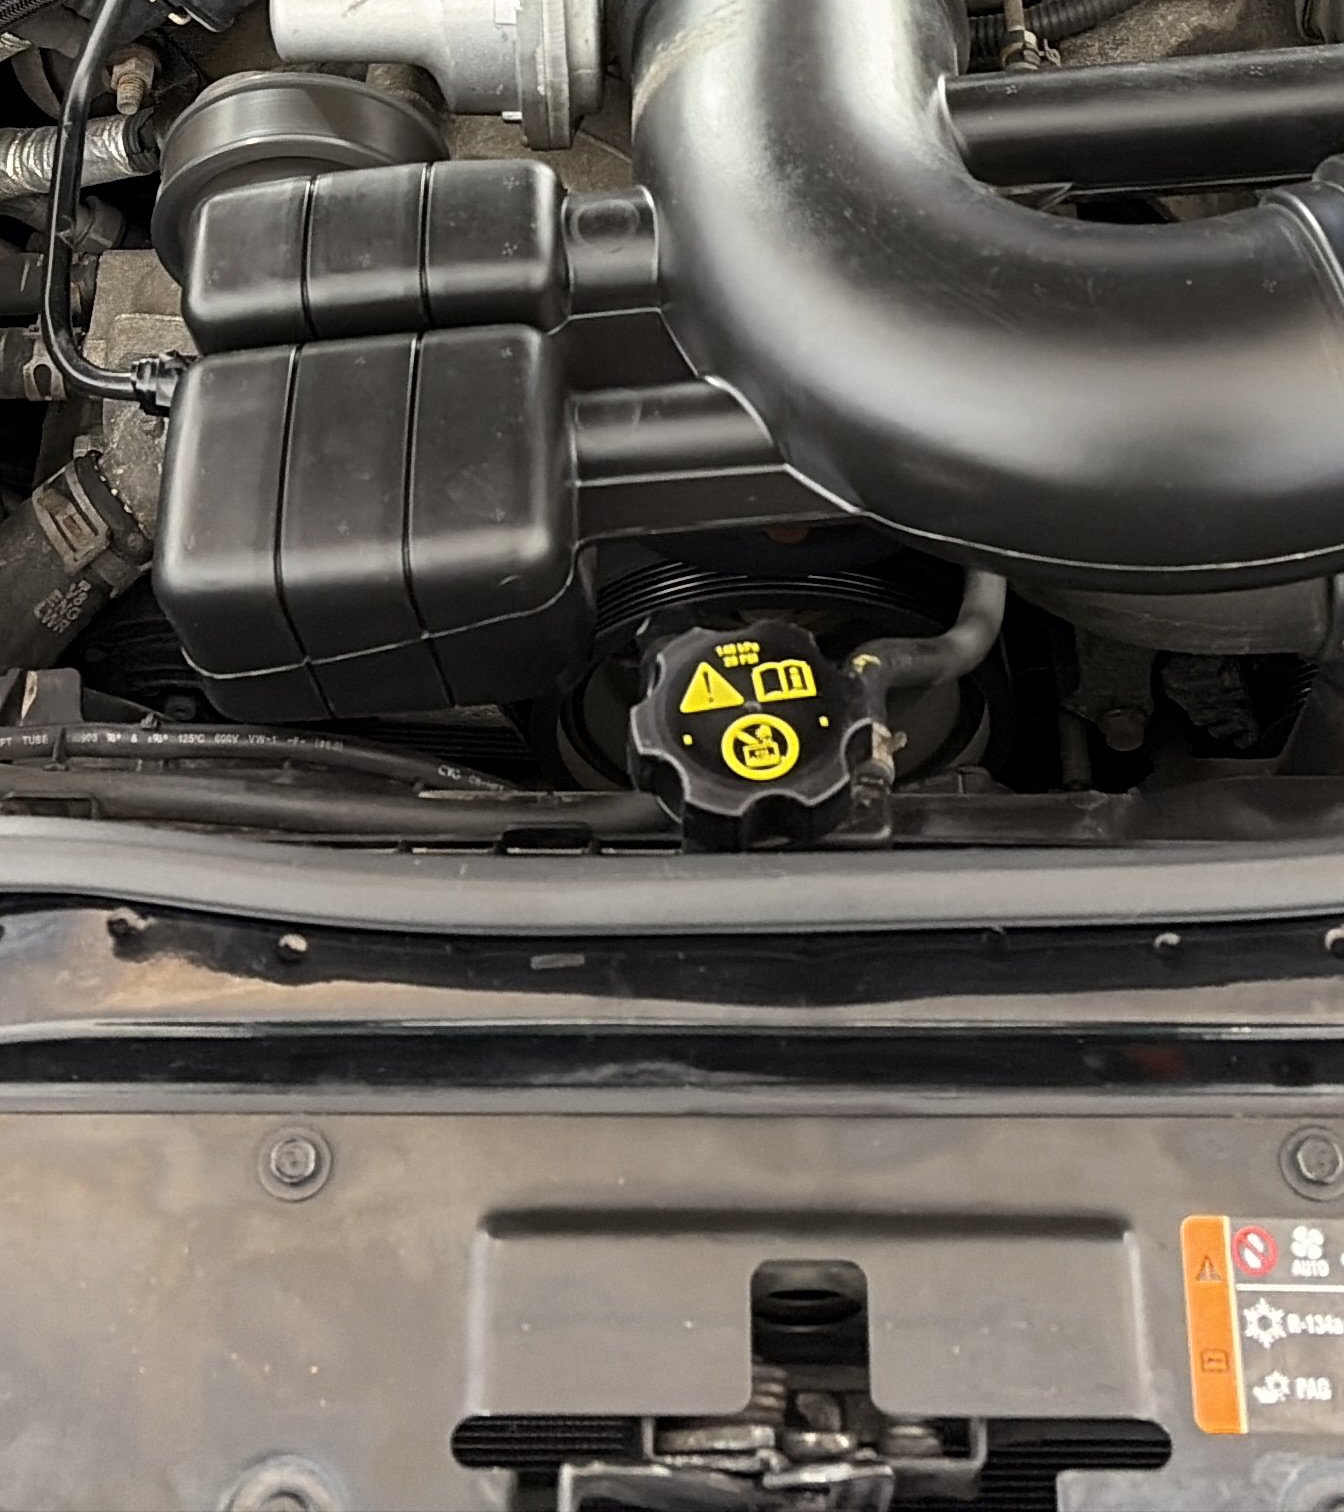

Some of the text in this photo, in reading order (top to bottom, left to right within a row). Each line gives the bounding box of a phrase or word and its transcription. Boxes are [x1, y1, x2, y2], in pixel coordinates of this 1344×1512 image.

[34, 599, 70, 633] LWR
[47, 589, 82, 620] ENG
[22, 734, 49, 745] TUBE
[1292, 1259, 1330, 1278] AUTO
[1296, 1377, 1332, 1400] PAG
